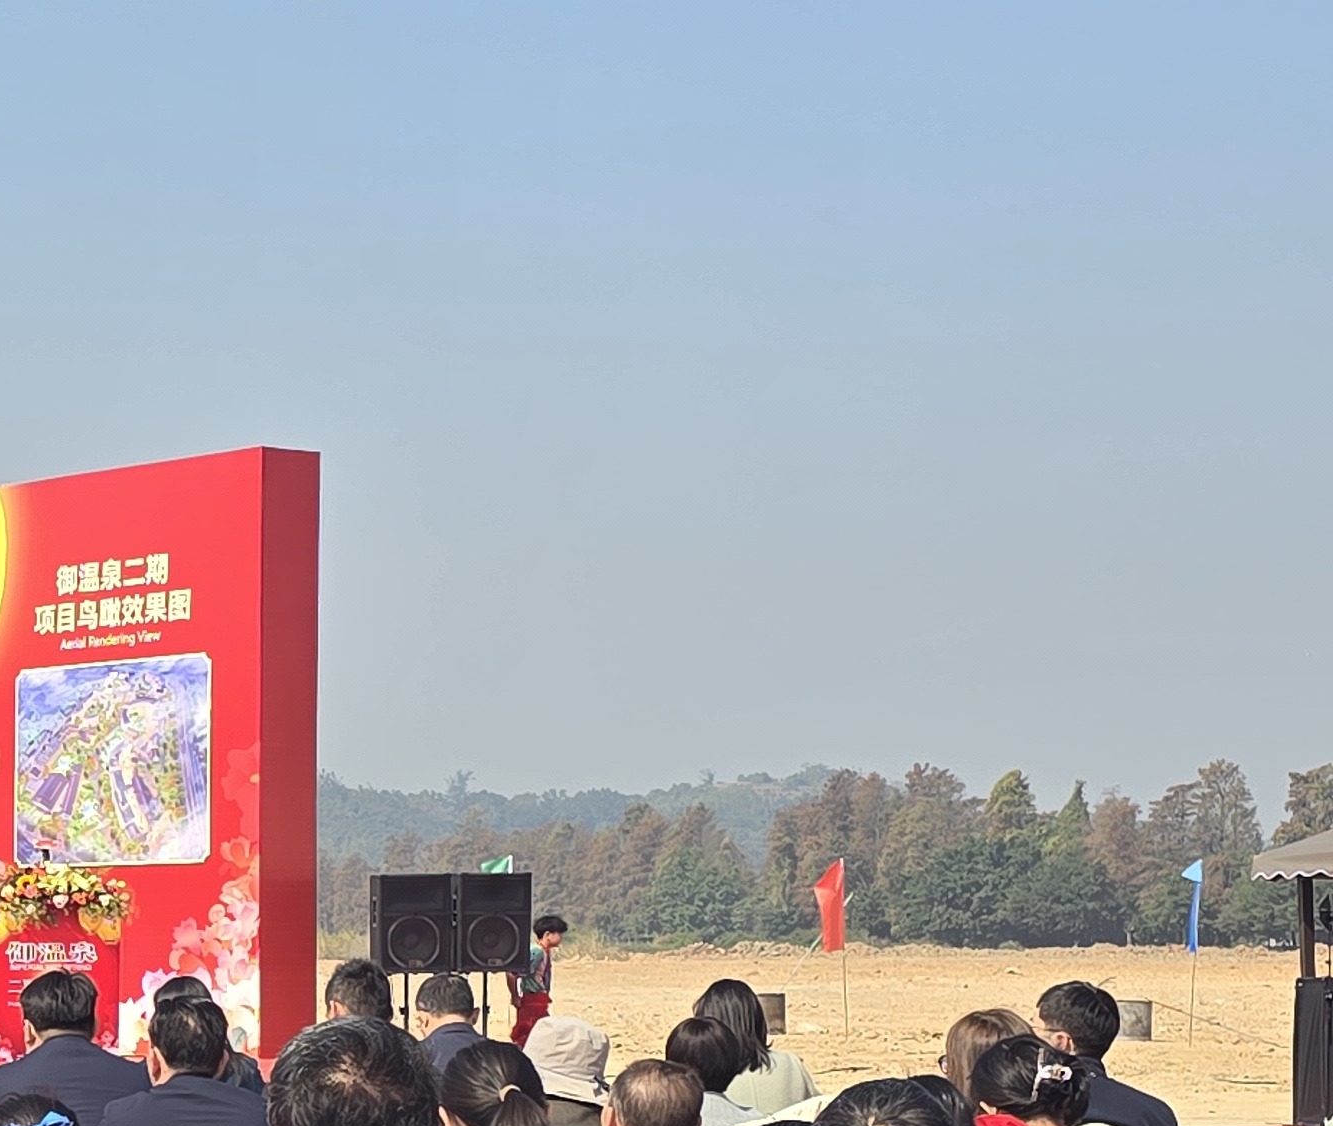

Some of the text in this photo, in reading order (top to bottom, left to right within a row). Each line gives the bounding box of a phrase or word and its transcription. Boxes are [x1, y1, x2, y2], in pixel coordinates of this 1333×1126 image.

[56, 553, 169, 596] 御温泉二期
[34, 588, 192, 635] 项目鸟瞰效果图
[60, 630, 161, 651] Aerial Rendering View
